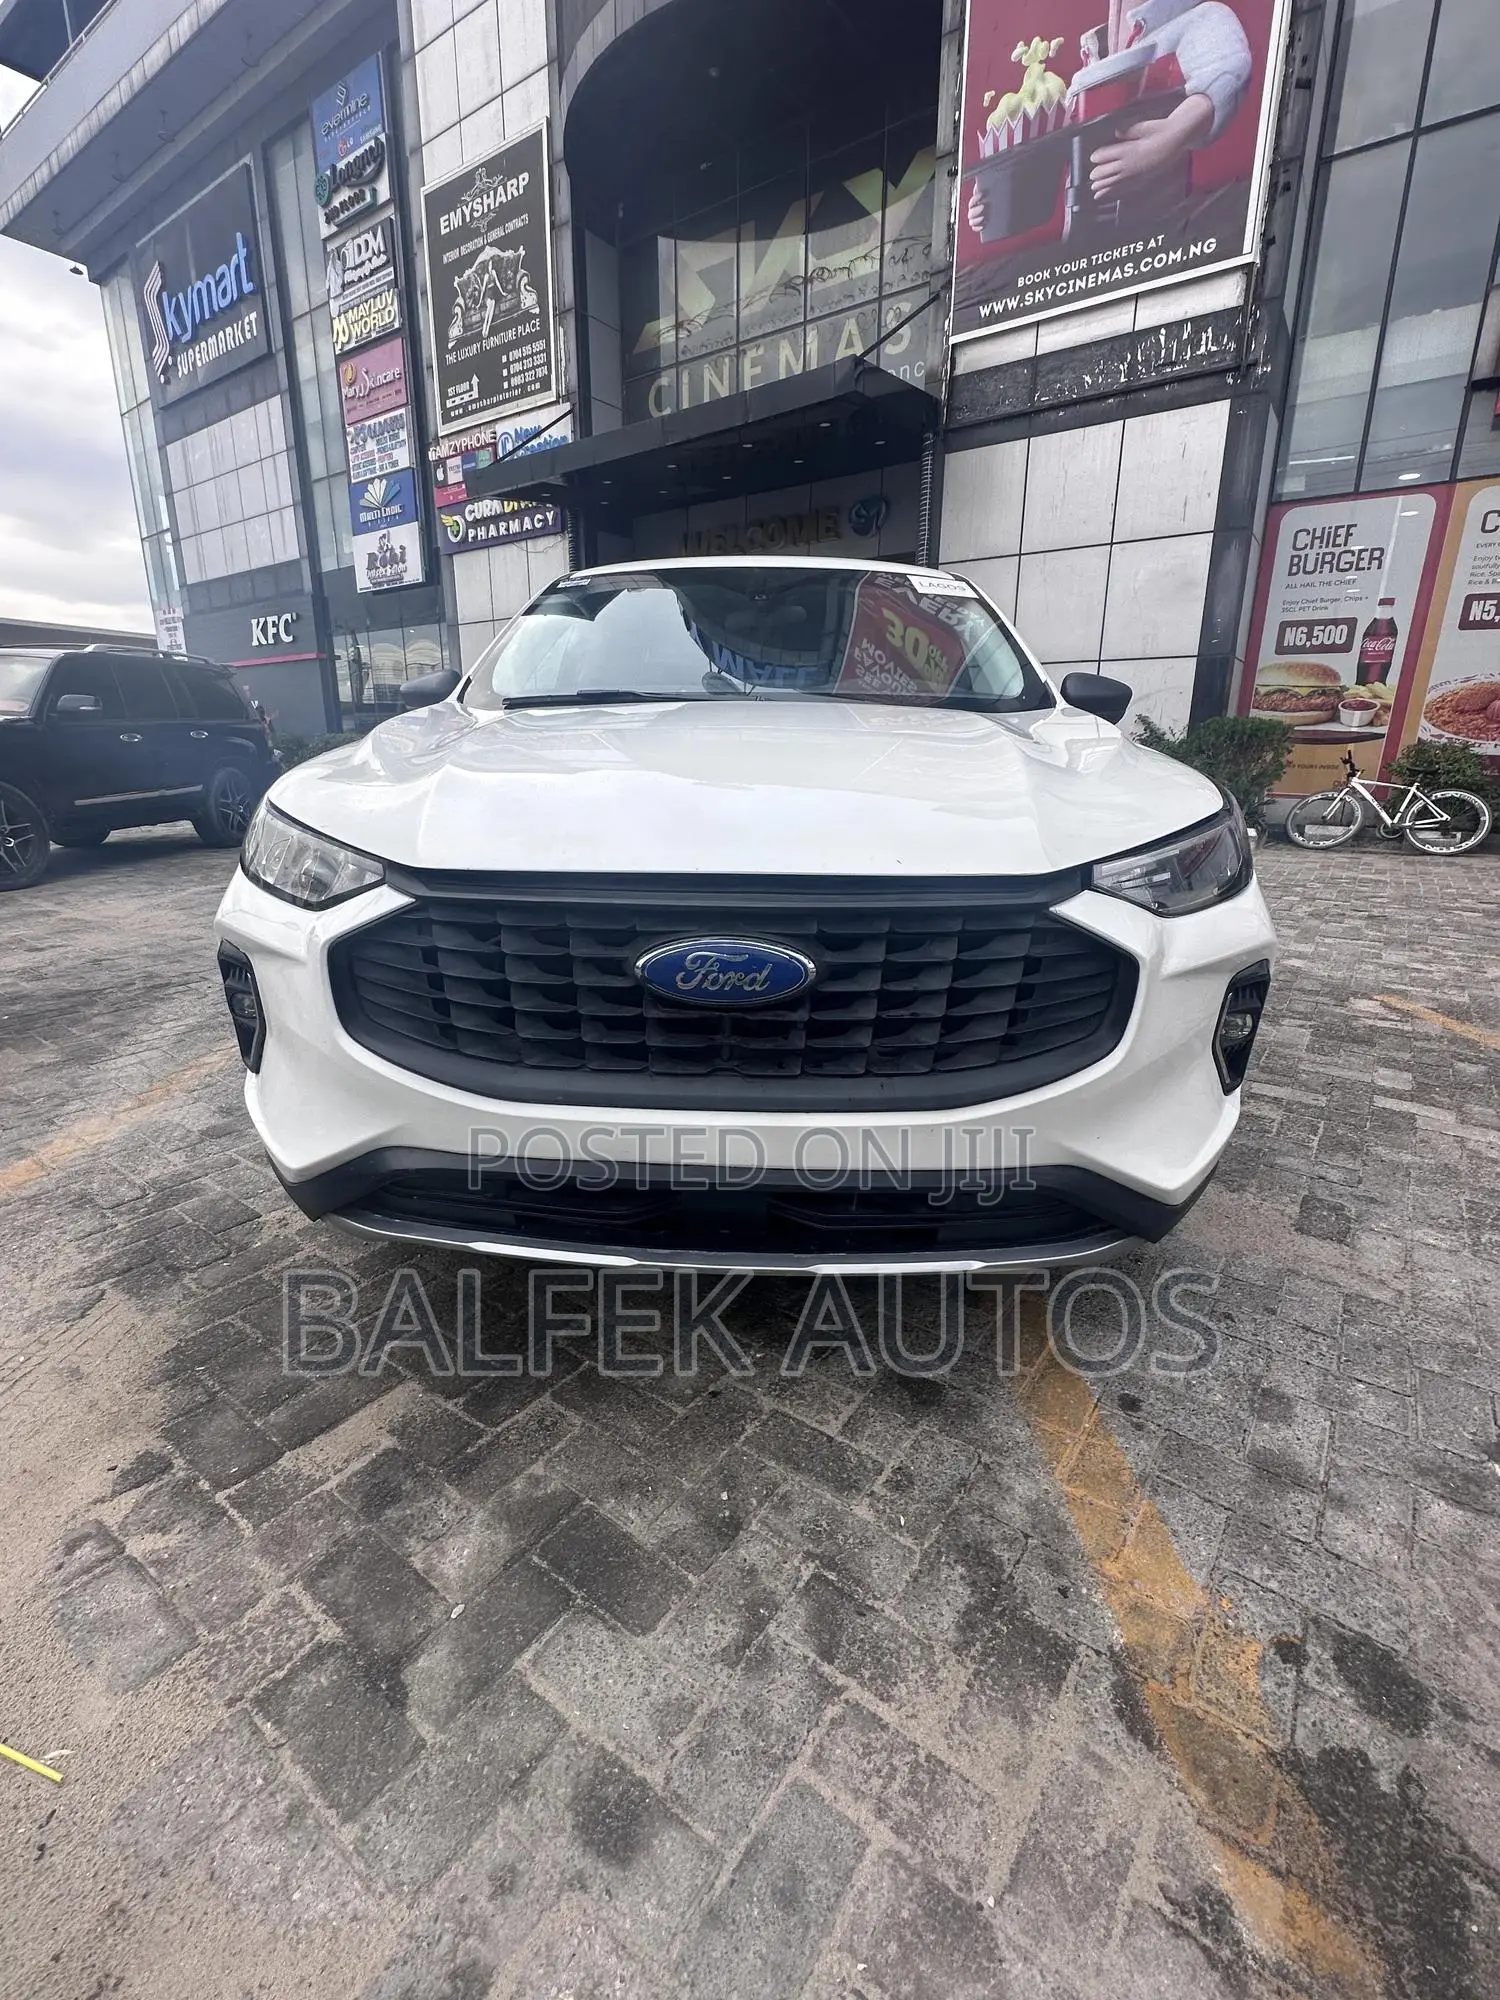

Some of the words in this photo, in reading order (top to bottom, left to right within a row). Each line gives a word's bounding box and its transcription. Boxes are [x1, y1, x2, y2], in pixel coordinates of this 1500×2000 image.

[440, 172, 530, 235] EMYSHARP
[442, 248, 460, 264] INTERIOR
[460, 236, 484, 257] DECORATION
[487, 225, 506, 242] GENERAL
[505, 213, 529, 235] CONTRACTS
[1017, 268, 1051, 287] BOOK
[1054, 258, 1088, 277] YOUR
[1091, 240, 1144, 266] TICKETS
[1146, 234, 1165, 249] AT
[979, 237, 1217, 319] WWW.SKYCINEMAS.COM.NG
[349, 288, 393, 323] MAYLUV
[351, 306, 395, 338] WORLD
[176, 311, 258, 378] SUPERMARKET
[445, 351, 457, 366] THE
[457, 342, 481, 361] LUXURY
[482, 327, 517, 352] FURNITURE
[517, 318, 541, 338] PLACE
[648, 300, 913, 419] CINEMAS
[467, 510, 556, 543] PHARMACY
[680, 506, 841, 556] WELCOME
[1287, 547, 1385, 577] BURGER
[1334, 578, 1358, 586] CHIEF
[251, 612, 294, 647] KFC
[1283, 624, 1348, 648] N6,500
[675, 951, 773, 992] Ford
